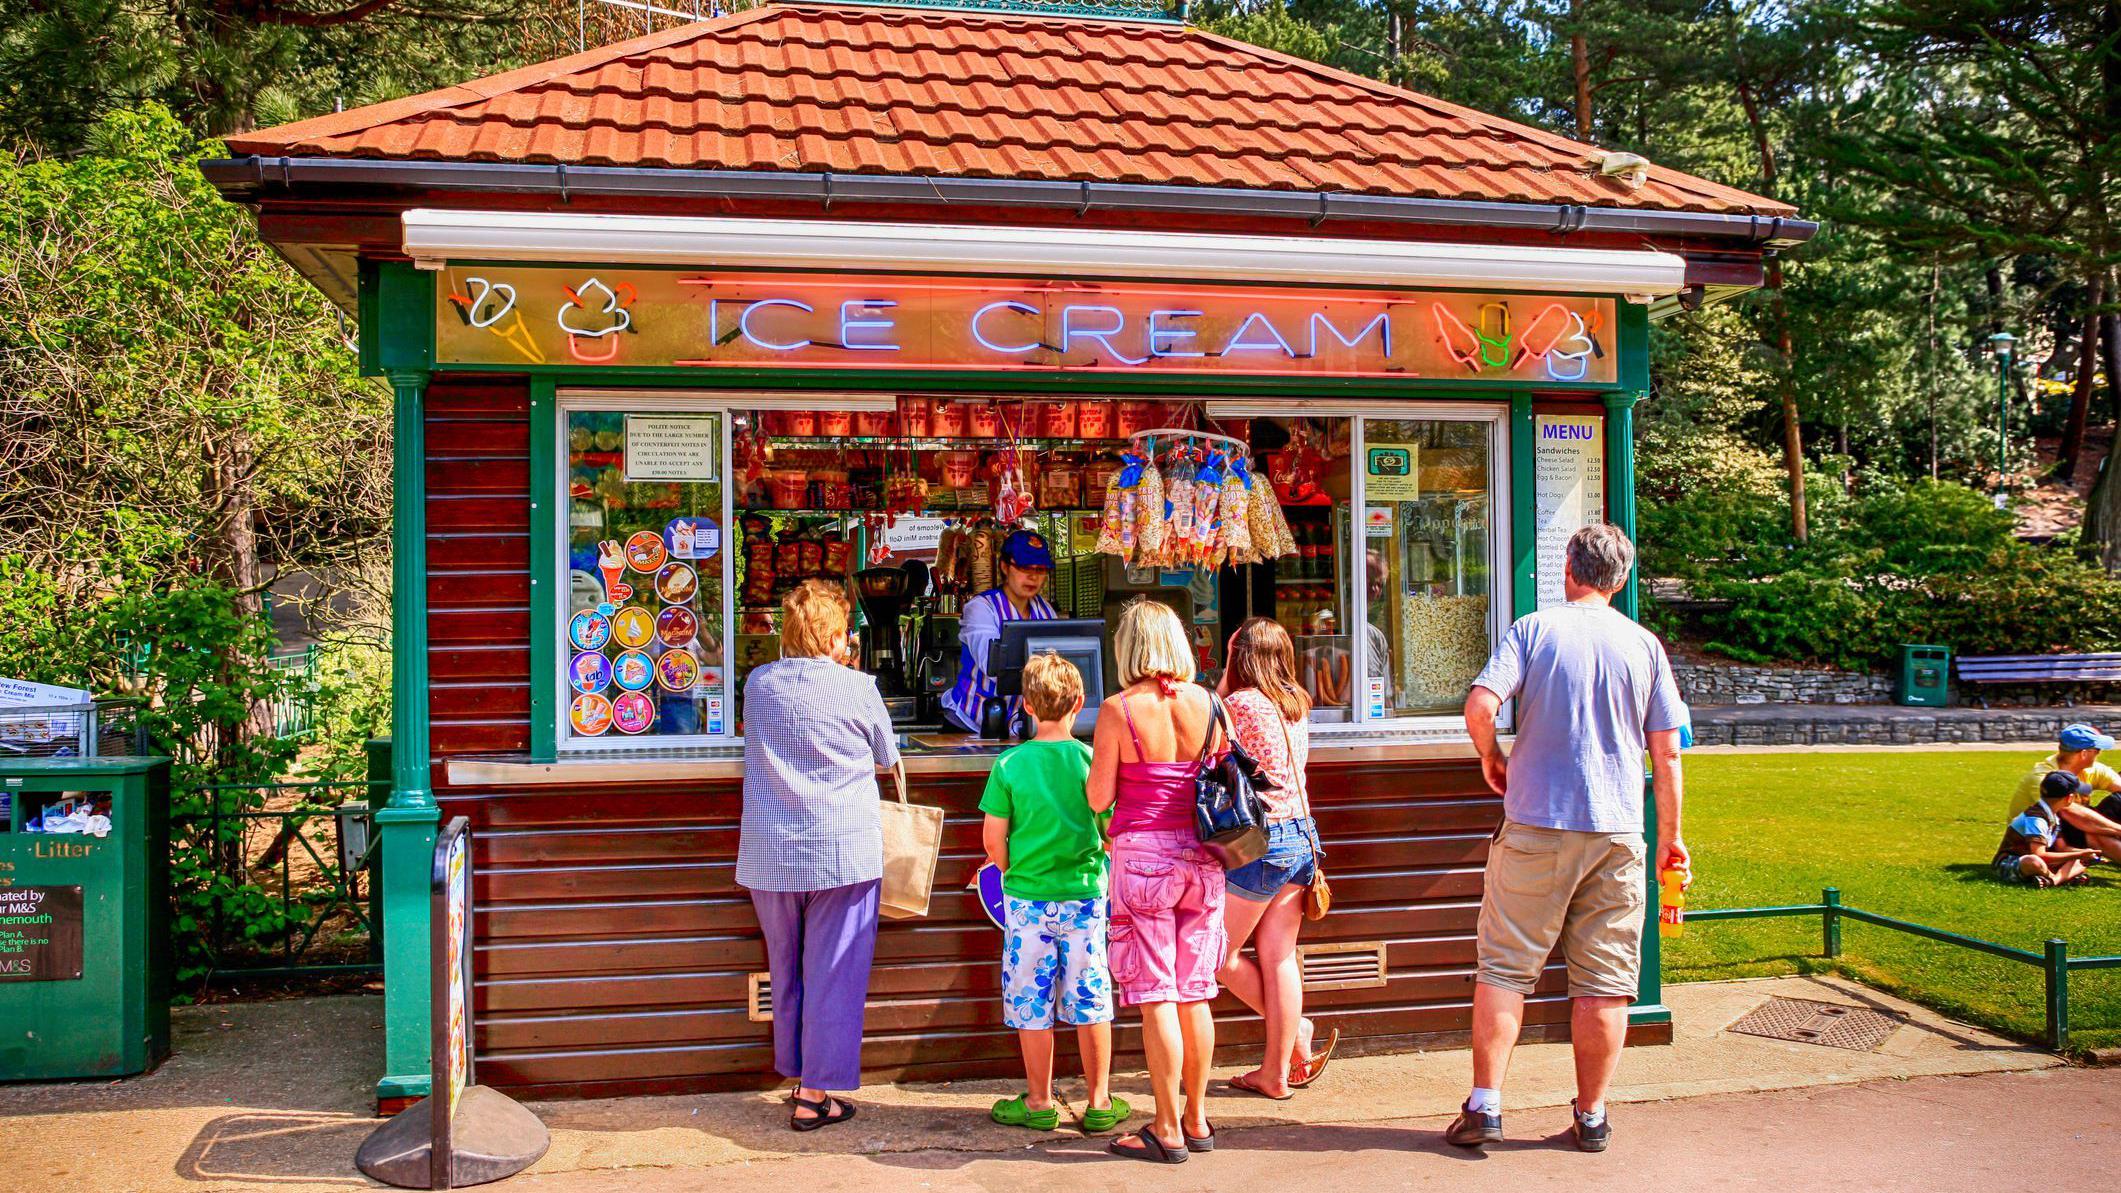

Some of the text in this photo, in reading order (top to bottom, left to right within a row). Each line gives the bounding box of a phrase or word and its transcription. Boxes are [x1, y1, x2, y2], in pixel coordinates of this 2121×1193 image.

[710, 299, 1392, 364] ICE CREAM
[1543, 424, 1593, 440] MENU
[1536, 446, 1581, 455] Sandwiches
[1559, 456, 1575, 464] Salad
[1538, 570, 1561, 578] Popcorn
[4, 689, 23, 697] Cream
[13, 683, 37, 693] Forest
[35, 841, 93, 858] Litter
[0, 889, 46, 903] ated by
[9, 902, 37, 914] M&S
[8, 938, 29, 946] there
[0, 957, 31, 973] M&S
